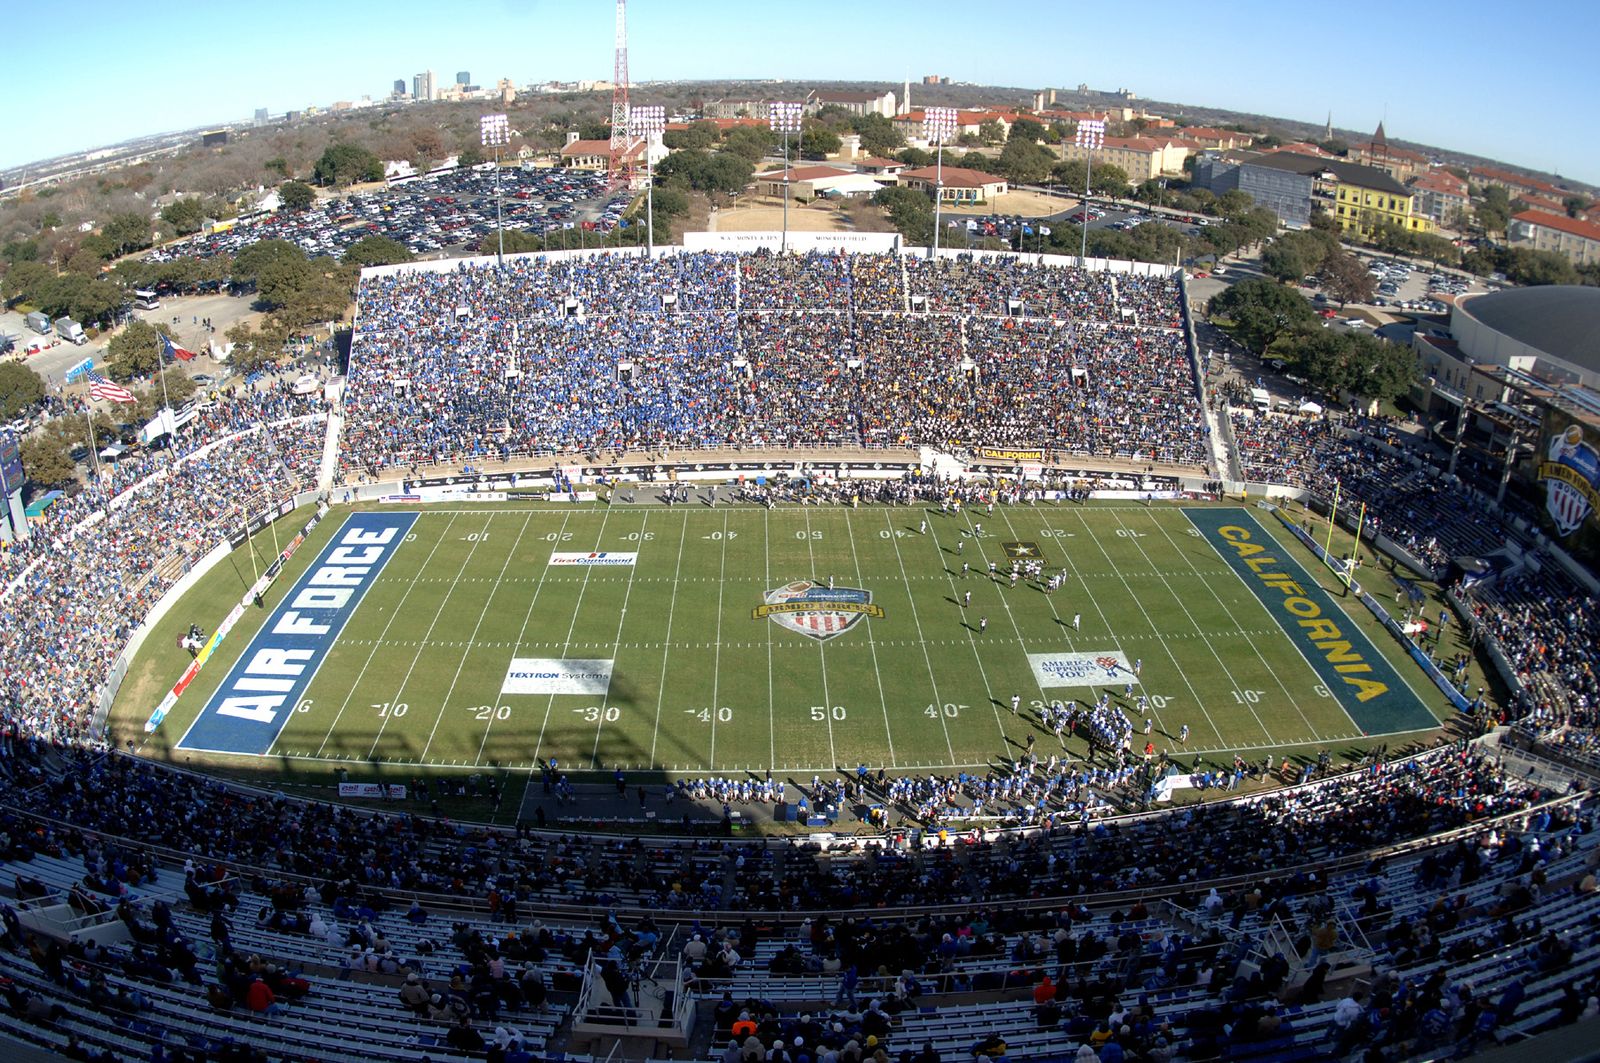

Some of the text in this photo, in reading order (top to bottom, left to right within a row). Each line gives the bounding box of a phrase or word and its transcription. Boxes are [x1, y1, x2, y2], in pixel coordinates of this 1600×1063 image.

[985, 449, 1042, 460] CALIFORNIA
[1217, 525, 1390, 703] CALIFORNIA
[216, 527, 400, 724] AIR FORCE
[1041, 660, 1094, 668] AMERICA
[561, 672, 609, 680] Systems
[1056, 671, 1086, 679] YOU
[1231, 689, 1260, 704] 10
[297, 699, 314, 713] G
[378, 703, 409, 717] 10
[475, 705, 513, 720] 20
[810, 706, 848, 721] 50
[924, 703, 959, 718] 40
[584, 706, 620, 722] 30
[696, 707, 733, 722] 40
